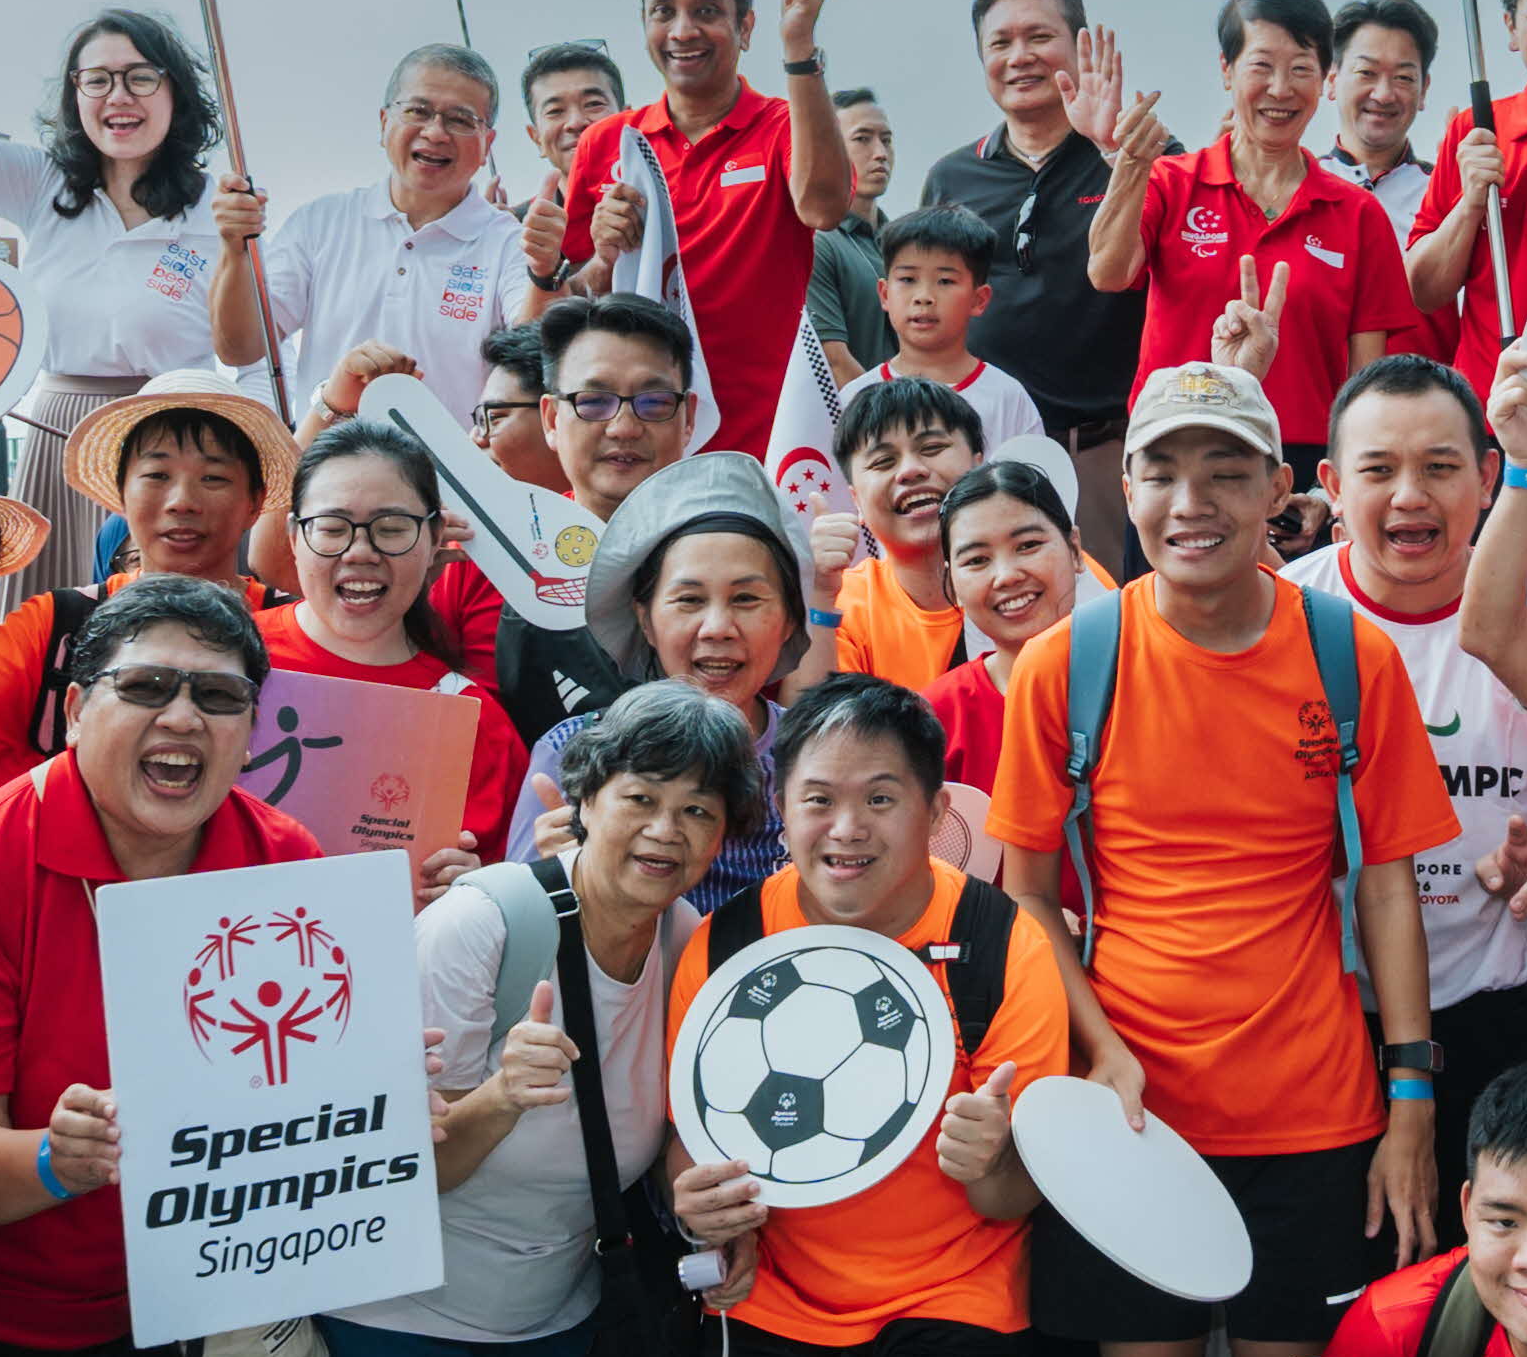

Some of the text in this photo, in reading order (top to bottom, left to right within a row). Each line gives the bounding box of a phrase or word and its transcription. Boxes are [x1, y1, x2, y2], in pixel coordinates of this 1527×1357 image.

[159, 254, 195, 280] side
[166, 240, 207, 271] east
[145, 277, 183, 301] side
[153, 265, 192, 293] best
[442, 287, 484, 308] best
[440, 305, 478, 322] side
[351, 825, 415, 841] Olympics
[360, 814, 411, 828] Special
[1416, 864, 1462, 876] PORE
[1416, 881, 1431, 892] 6
[170, 1094, 387, 1171] Special
[145, 1152, 419, 1229] Olympics
[195, 1215, 386, 1278] Singapore
